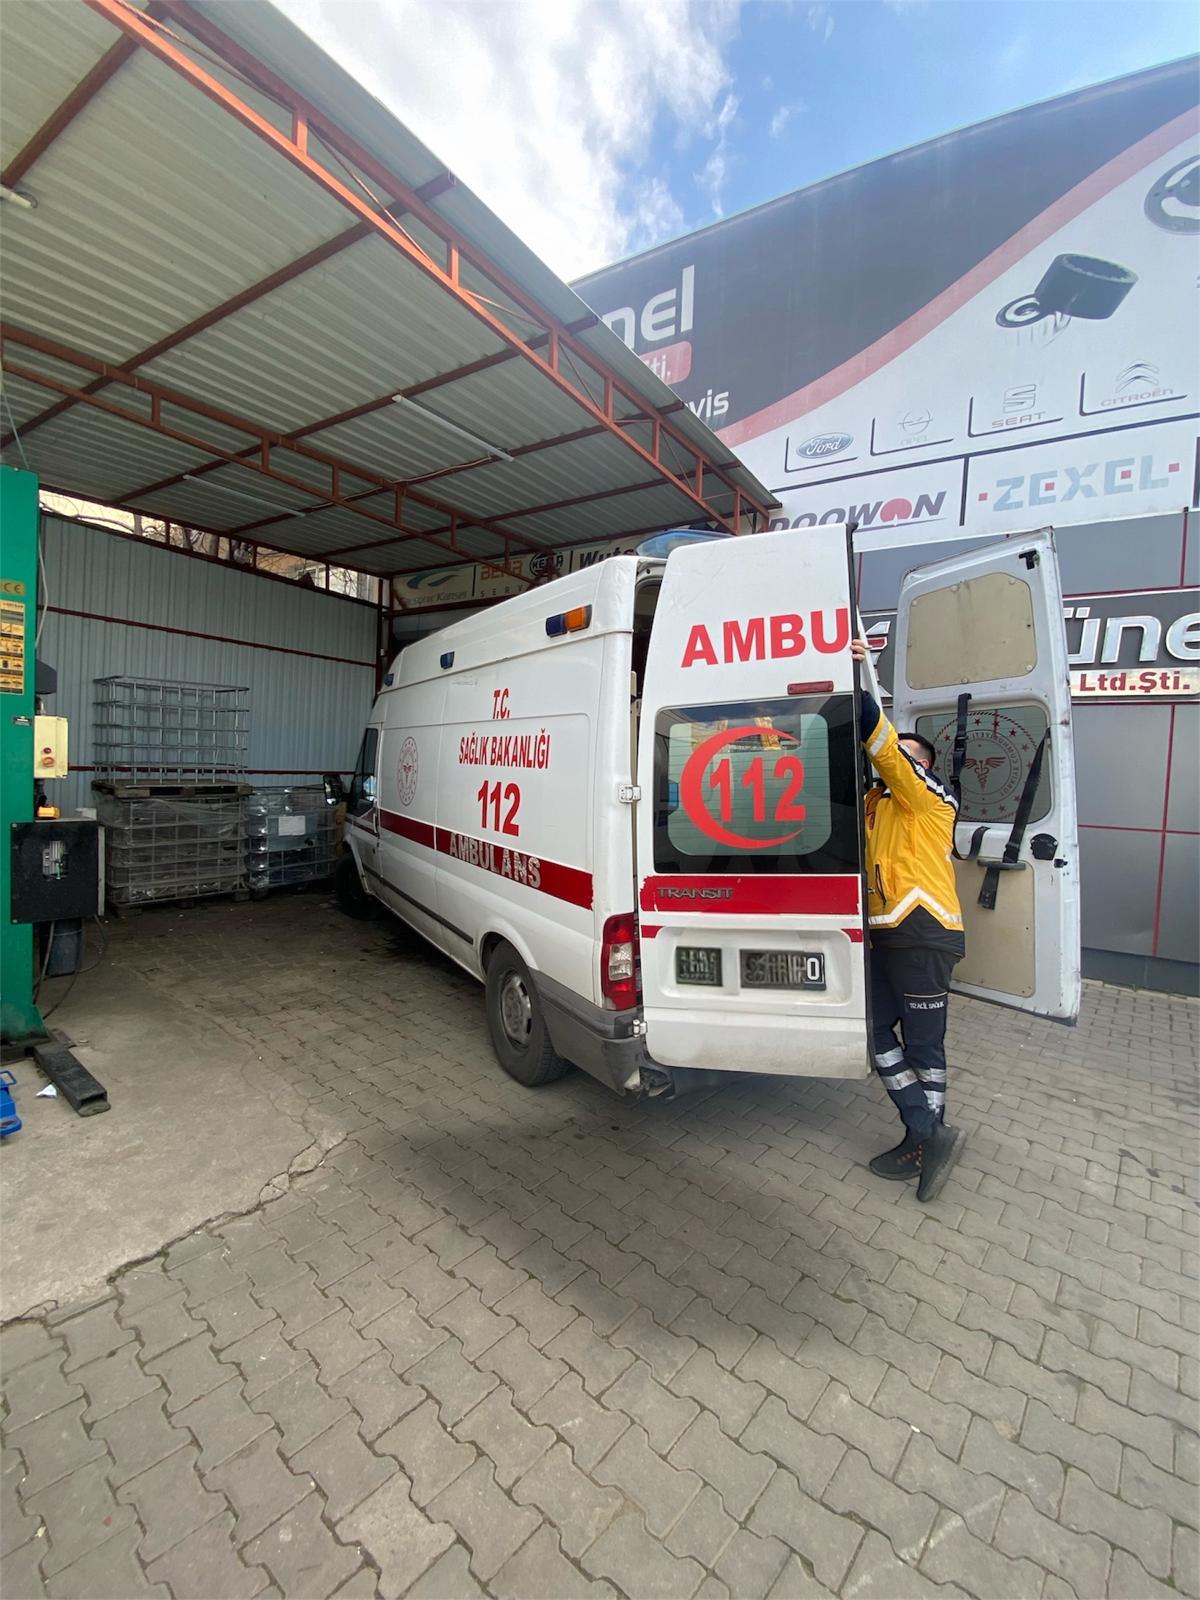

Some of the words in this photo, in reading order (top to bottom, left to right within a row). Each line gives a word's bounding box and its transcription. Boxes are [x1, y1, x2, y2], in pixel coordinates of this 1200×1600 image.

[991, 411, 1046, 429] SEAT
[806, 435, 842, 456] Ford
[993, 455, 1169, 512] ZEXEL
[681, 607, 849, 669] AMBU
[493, 687, 510, 719] T.C.
[1080, 671, 1190, 693] Ltd.Şti.
[459, 731, 489, 765] SAĞLIK
[489, 727, 551, 769] BAKANLIĞI
[477, 779, 521, 837] 112
[709, 755, 807, 823] 112
[449, 831, 541, 888] AMBULANS
[657, 886, 734, 900] TRANSIT
